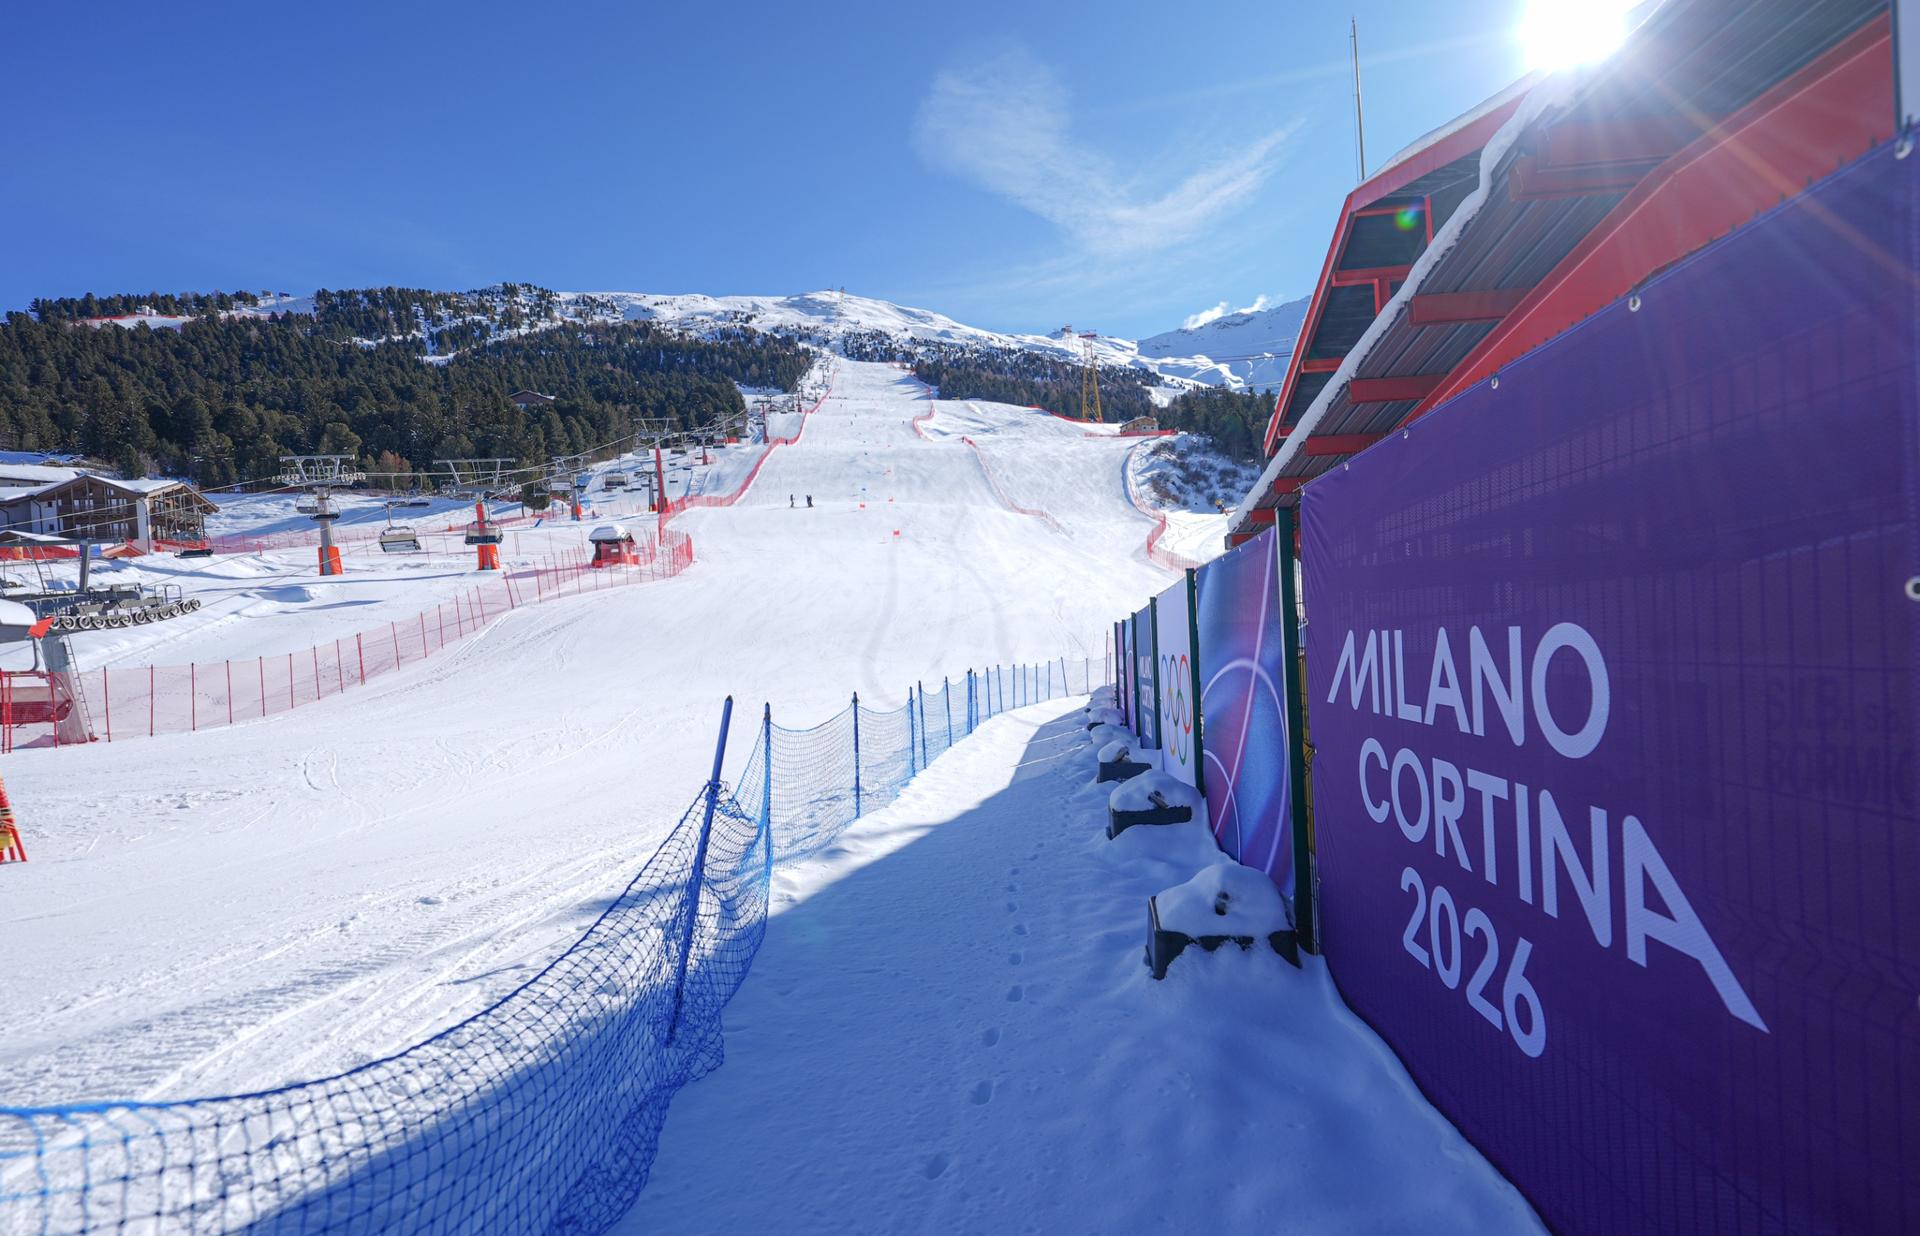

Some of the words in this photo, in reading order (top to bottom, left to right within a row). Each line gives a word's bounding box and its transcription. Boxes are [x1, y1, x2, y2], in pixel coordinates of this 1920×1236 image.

[1327, 622, 1610, 759] MILANO
[1358, 737, 1769, 1033] CORTINA
[1400, 866, 1546, 1058] 2026
